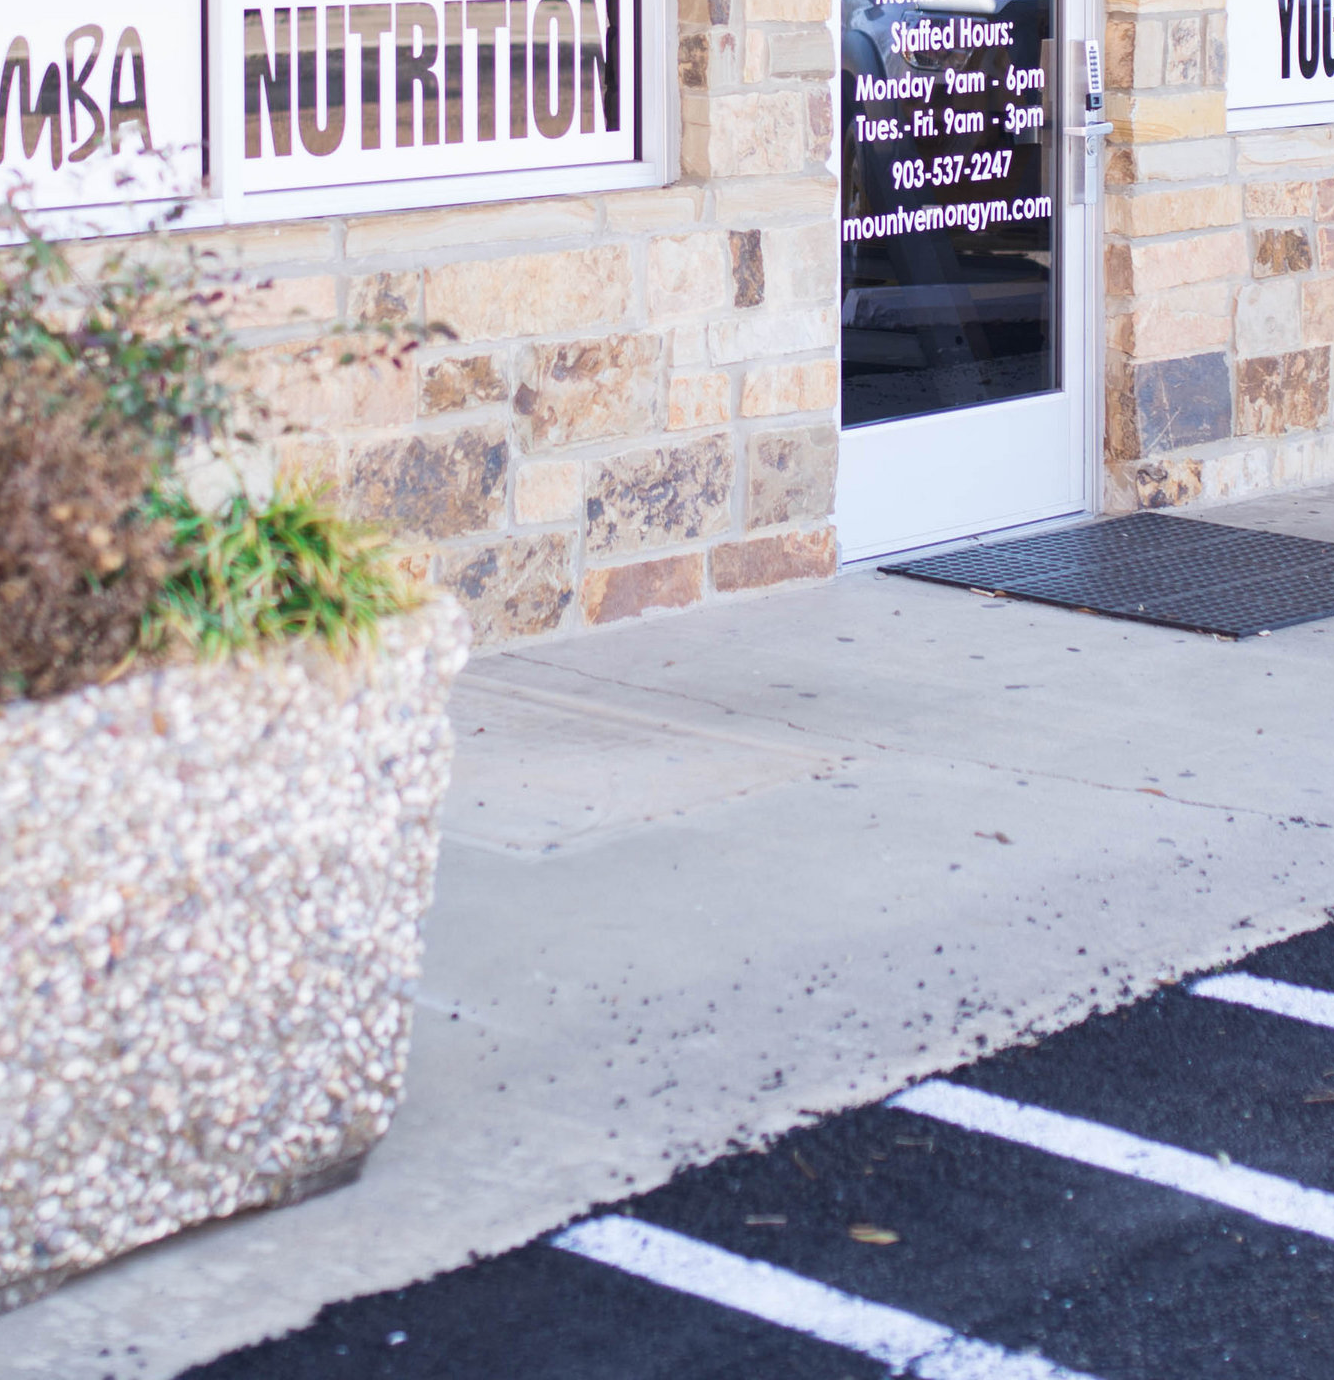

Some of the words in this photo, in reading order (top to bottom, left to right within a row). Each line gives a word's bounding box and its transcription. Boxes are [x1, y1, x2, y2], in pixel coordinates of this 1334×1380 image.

[890, 18, 955, 54] Staffed
[960, 17, 1014, 49] Hours:
[855, 71, 935, 104] Monday
[944, 67, 985, 95] 9am
[1006, 64, 1045, 96] 6pm
[943, 108, 984, 135] 9am
[1004, 103, 1044, 135] 3pm
[892, 149, 1013, 190] 903-537-2247
[843, 196, 1052, 242] mountvernongym.com
